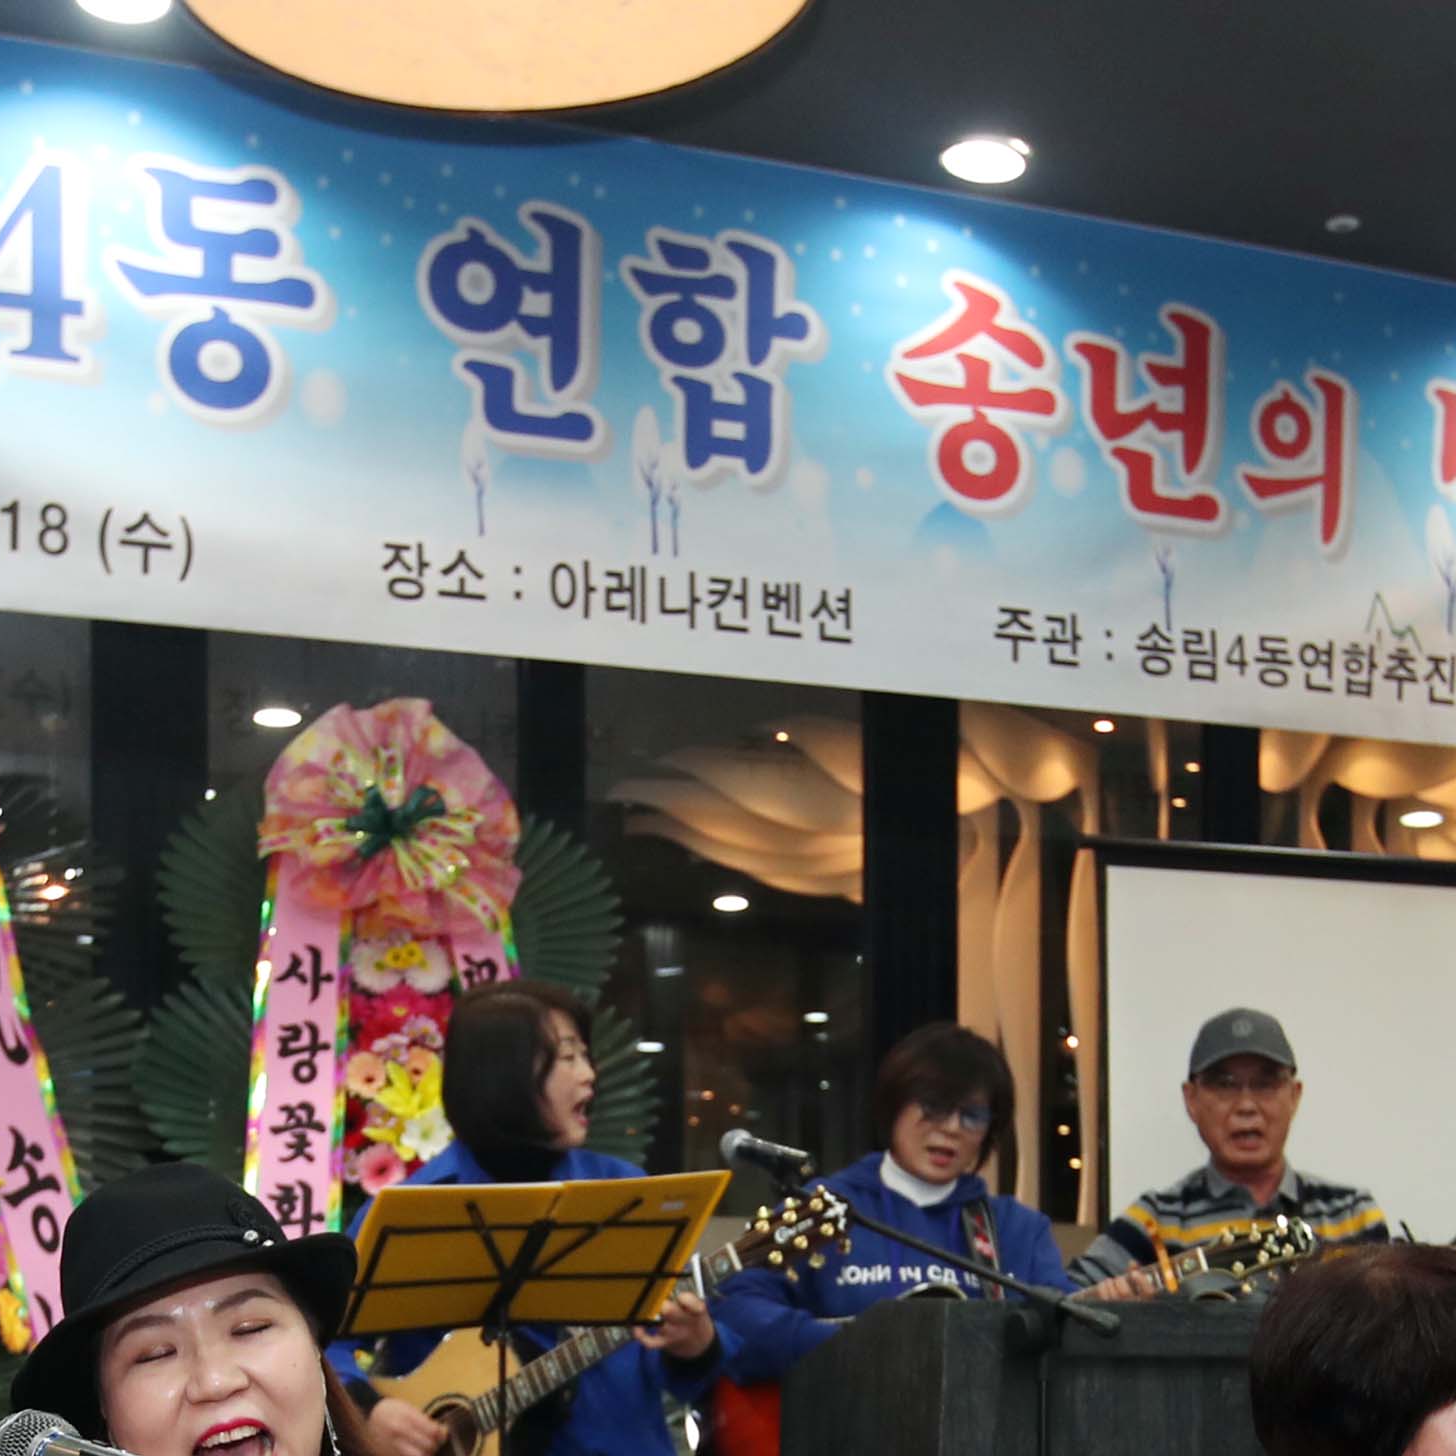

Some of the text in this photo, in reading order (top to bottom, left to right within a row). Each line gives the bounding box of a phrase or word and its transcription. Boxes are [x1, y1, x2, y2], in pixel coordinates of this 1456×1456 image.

[427, 204, 814, 476] 연합
[892, 278, 1347, 546] 송년의
[96, 506, 196, 581] (수)
[381, 541, 488, 602] 장소
[549, 559, 855, 645] 아레나컨벤션
[993, 604, 1083, 668] 주관
